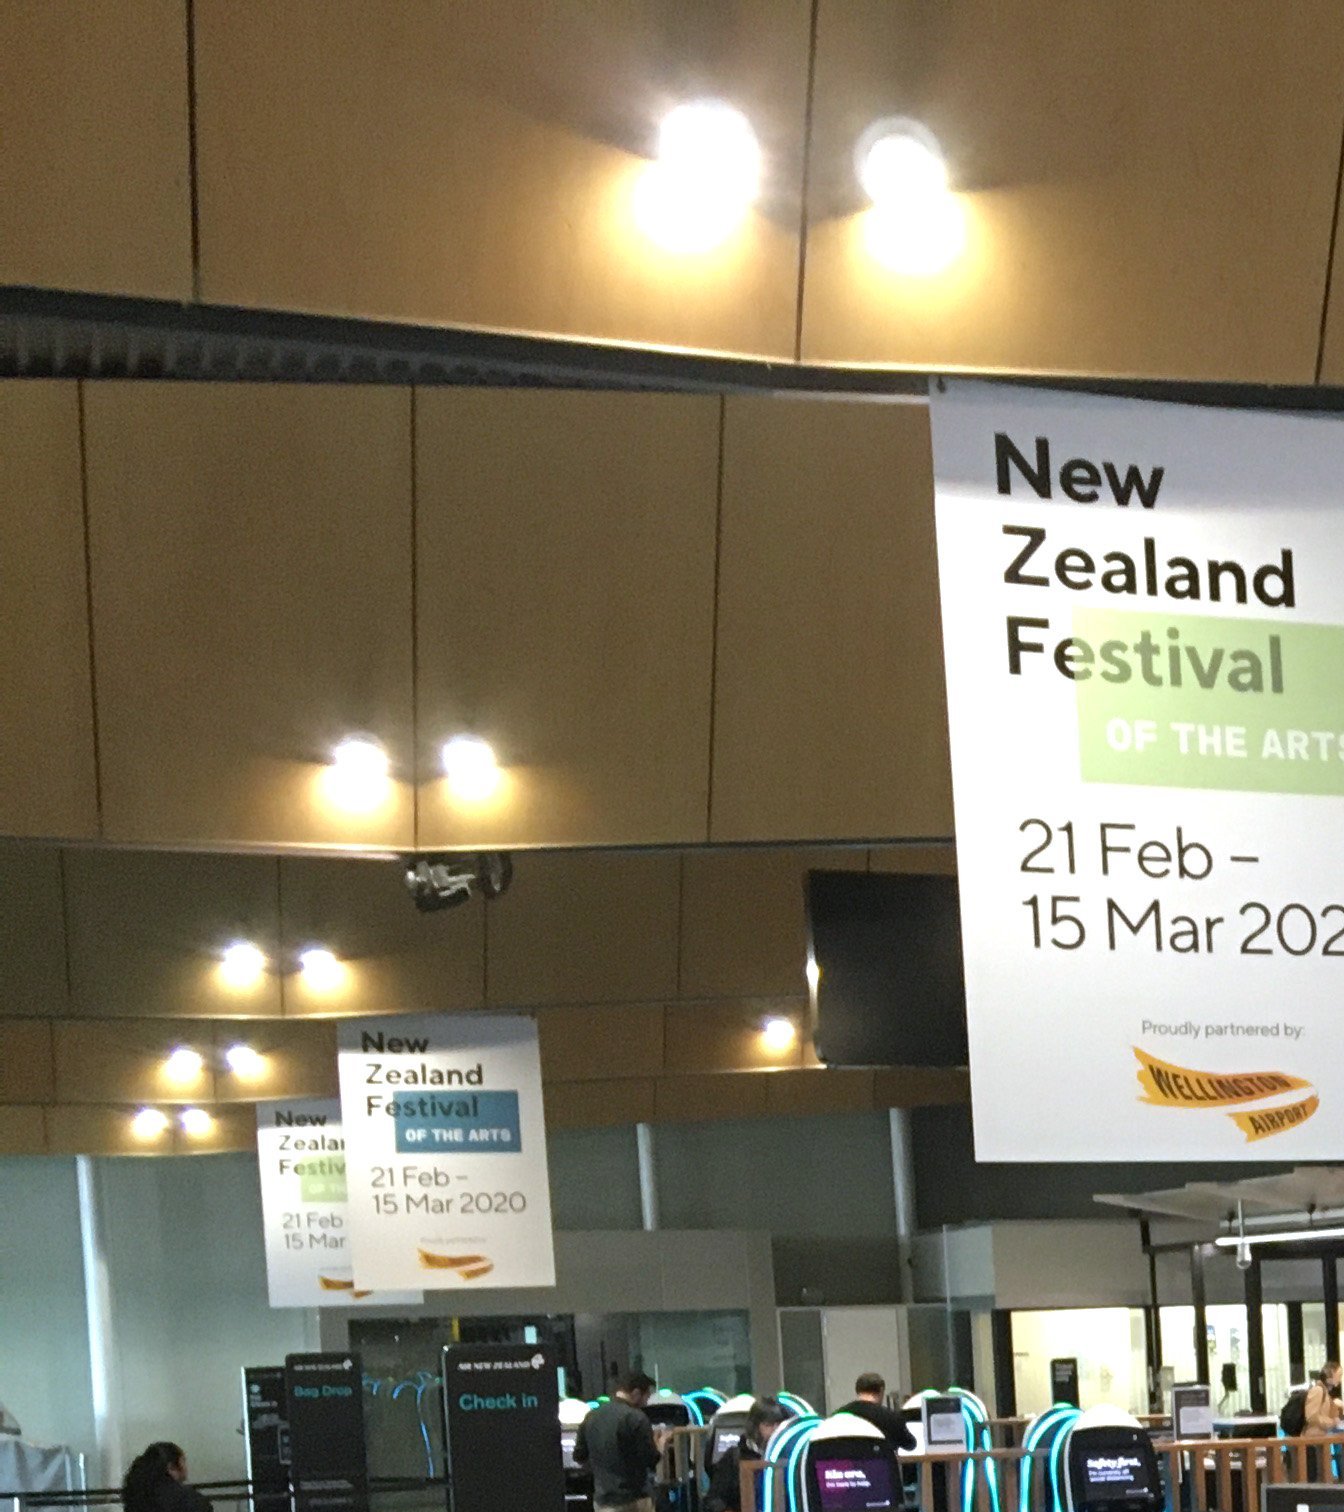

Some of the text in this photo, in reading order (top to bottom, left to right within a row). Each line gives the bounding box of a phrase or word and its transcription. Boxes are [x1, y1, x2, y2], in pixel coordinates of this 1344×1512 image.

[994, 433, 1164, 508] New
[1002, 525, 1297, 608] Zealand
[1006, 616, 1284, 694] Festival
[1106, 718, 1158, 750] OF
[1175, 722, 1246, 759] THE
[1018, 819, 1077, 874] 21
[1100, 823, 1213, 880] Feb
[1022, 895, 1087, 950] 15
[1106, 900, 1224, 954] Mar
[1142, 1020, 1200, 1039] Proudly
[1205, 1022, 1279, 1038] partnered
[361, 1030, 429, 1054] New
[366, 1063, 483, 1086] Zealand
[1149, 1064, 1291, 1101] WELLINGTON
[367, 1095, 480, 1118] Festival
[274, 1110, 327, 1127] New
[1249, 1103, 1308, 1135] AIRPORT
[405, 1128, 512, 1142] OF THE ARTS
[371, 1166, 394, 1188] 21
[403, 1165, 450, 1188] Feb
[372, 1191, 527, 1215] 15 Mar 2020
[282, 1211, 343, 1230] 21 Feb
[284, 1233, 345, 1250] 15 Mar
[293, 1385, 353, 1398] Bag Drop
[459, 1392, 538, 1411] Check in
